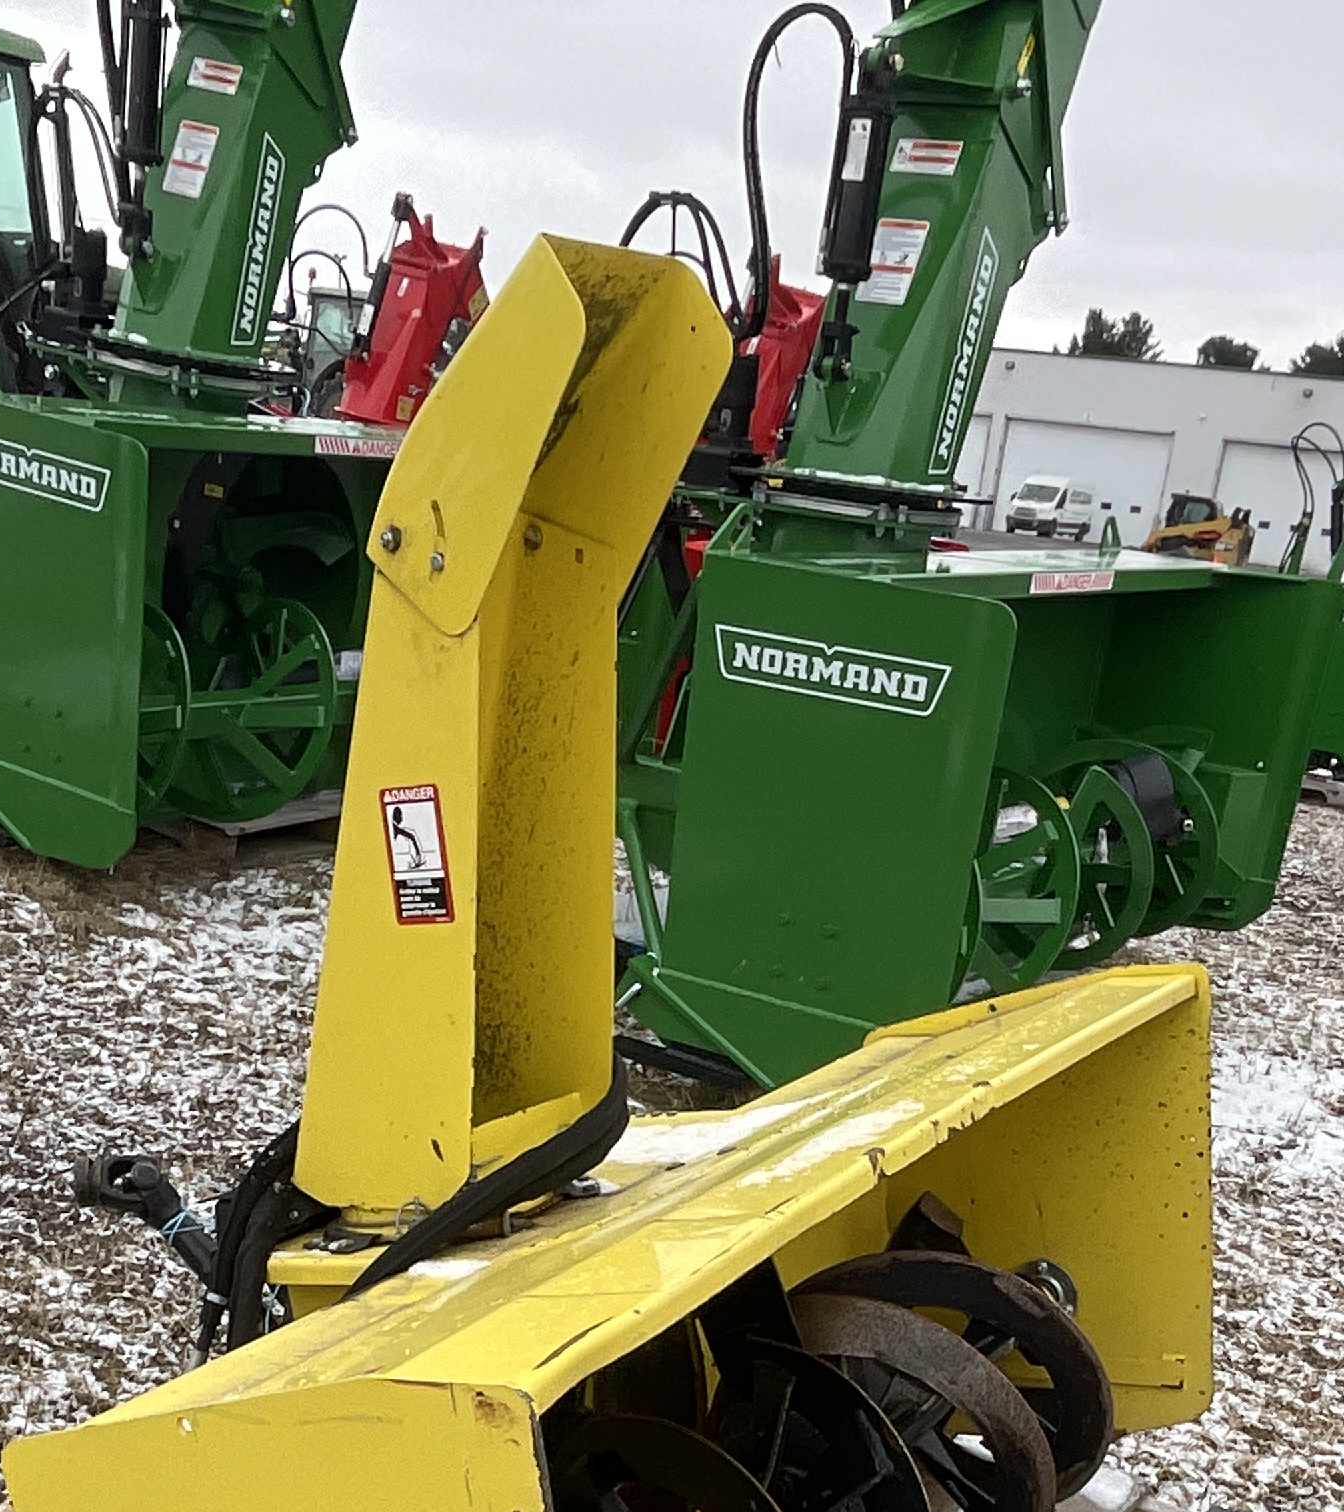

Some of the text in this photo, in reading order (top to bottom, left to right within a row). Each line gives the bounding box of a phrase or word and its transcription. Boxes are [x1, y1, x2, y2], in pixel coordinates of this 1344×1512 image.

[239, 154, 280, 334] NORMAND
[937, 253, 994, 461] NORMAND
[732, 641, 929, 702] NORMAND
[390, 786, 435, 801] DANGER
